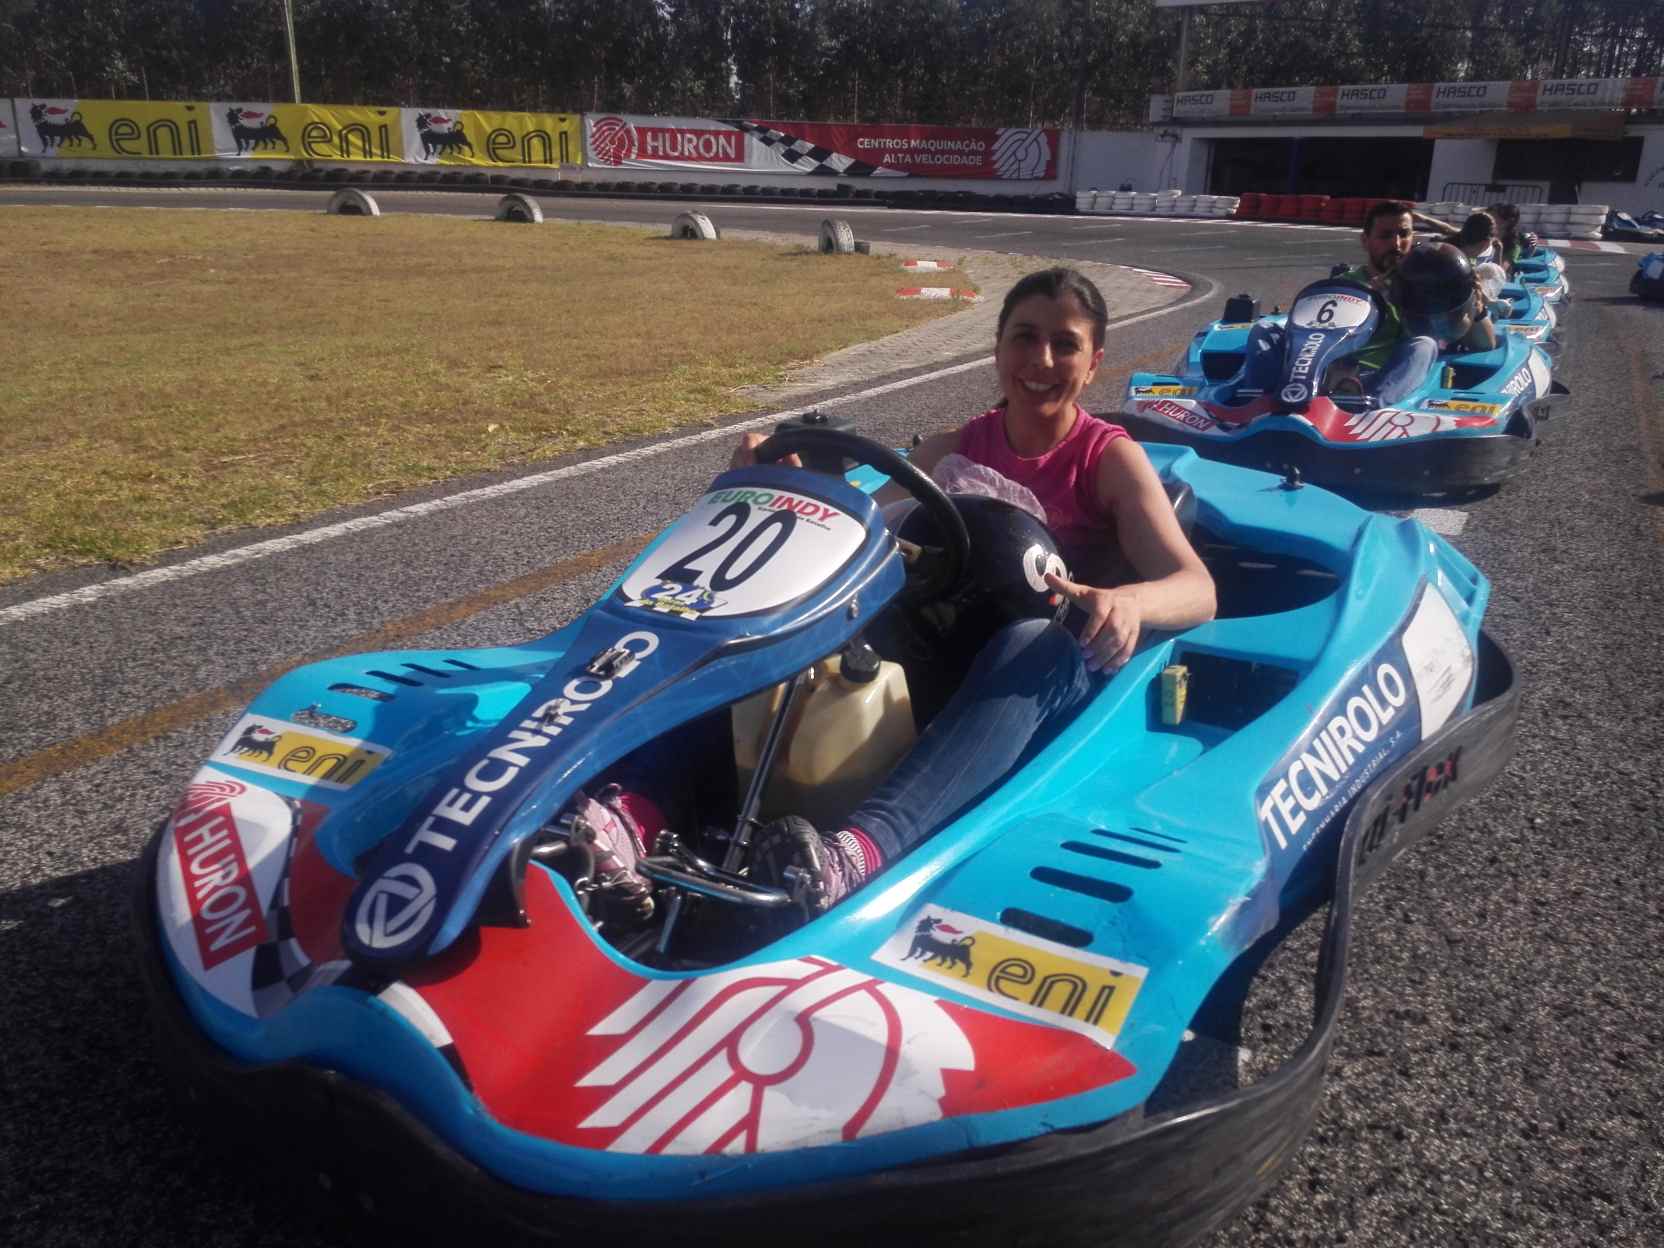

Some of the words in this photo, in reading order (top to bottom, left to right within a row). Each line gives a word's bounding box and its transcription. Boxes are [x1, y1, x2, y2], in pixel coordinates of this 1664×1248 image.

[1175, 94, 1214, 105] HASCO
[1254, 90, 1296, 102] HASCO
[1340, 87, 1386, 100] HASCO
[1436, 85, 1487, 98] HASCO
[1542, 82, 1599, 96] HASCO
[108, 105, 197, 156] eni
[302, 110, 391, 159] eni
[486, 117, 568, 164] eni
[646, 131, 736, 160] HURON
[856, 138, 909, 149] CENTROS
[910, 138, 986, 152] MAQUINAÇÃO
[882, 153, 912, 164] ALTA
[913, 154, 983, 166] VELOCIDADE
[1317, 299, 1338, 324] 6
[1159, 401, 1213, 431] HURON
[708, 489, 841, 521] EUROINDY
[656, 501, 798, 592] 20
[278, 746, 375, 784] eni
[1260, 663, 1406, 850] TECNIROLO
[184, 815, 257, 952] HURON
[986, 957, 1124, 1026] eni
